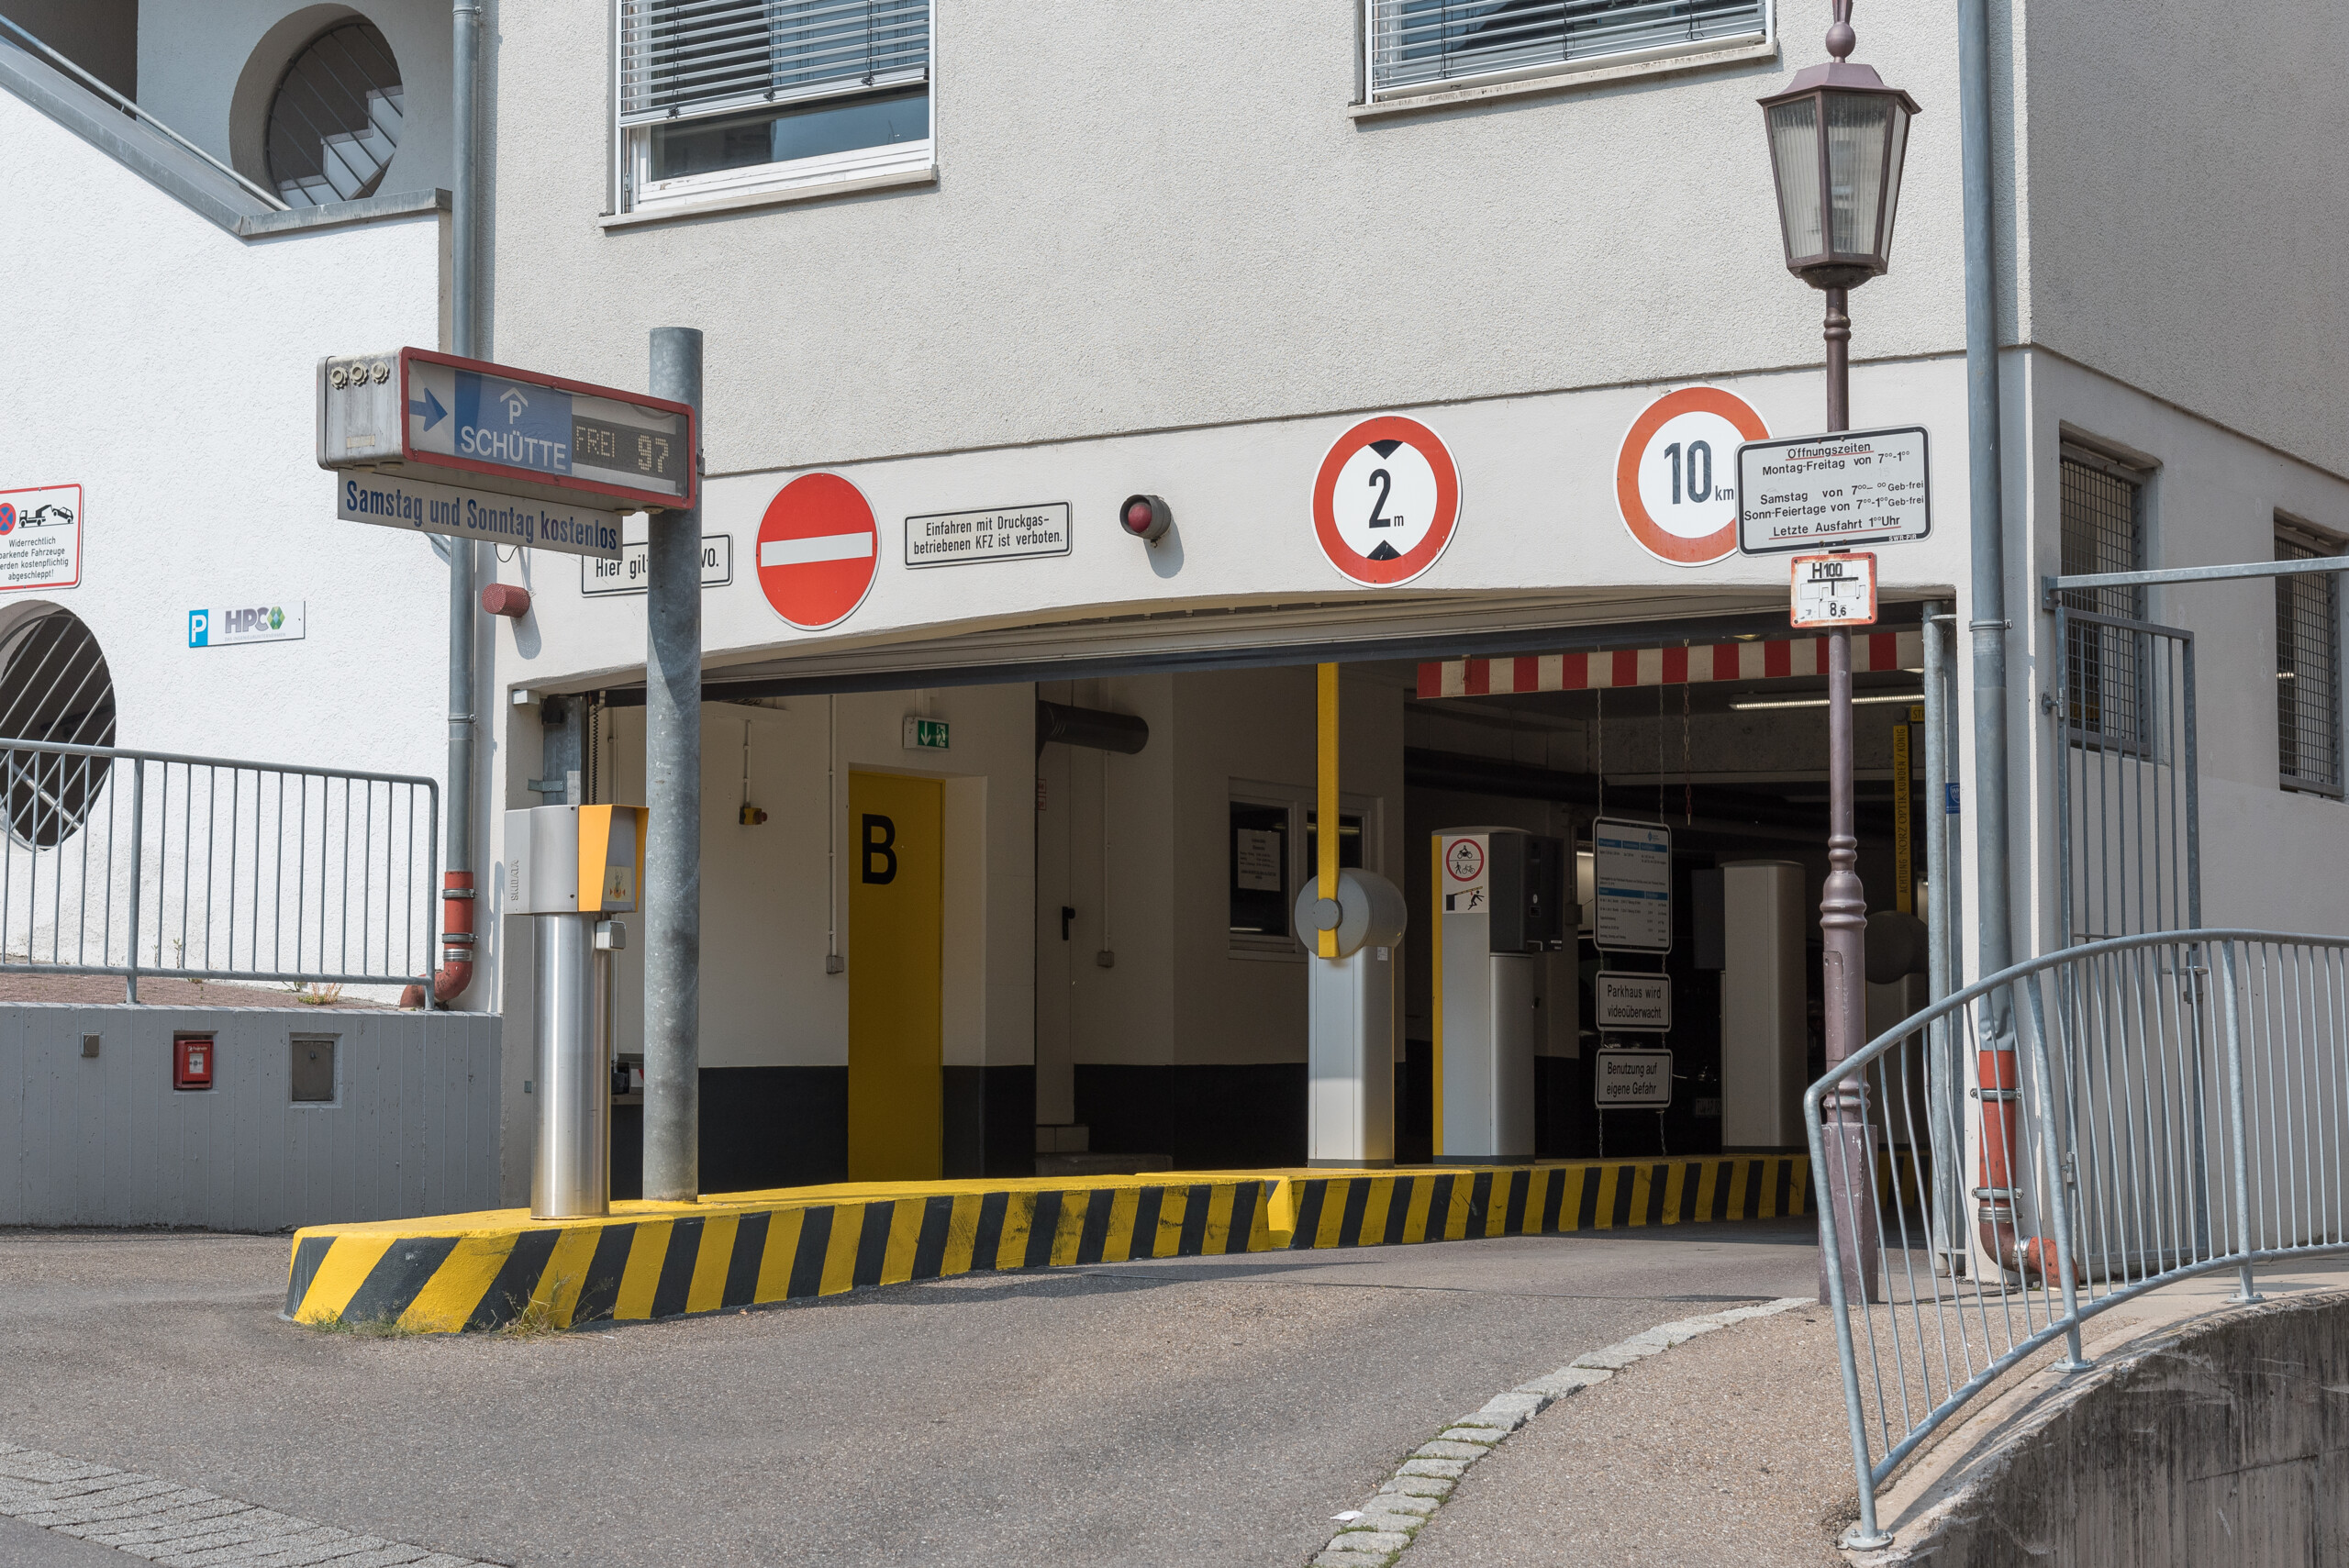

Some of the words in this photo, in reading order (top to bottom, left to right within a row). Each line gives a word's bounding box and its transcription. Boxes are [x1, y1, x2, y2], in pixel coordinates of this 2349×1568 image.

[509, 400, 522, 425] P
[461, 426, 566, 471] SCHÜTTE
[576, 426, 615, 458] FREI
[638, 434, 669, 473] 97
[1787, 442, 1871, 460] Öffnungszeiten
[1664, 439, 1712, 505] 10
[1714, 484, 1734, 502] km
[1762, 459, 1845, 476] Montag-Freitag
[1854, 455, 1872, 467] von
[1368, 468, 1391, 528] 2
[1394, 515, 1404, 527] m
[1760, 492, 1809, 506] Samstag
[1822, 488, 1843, 498] von
[1887, 480, 1924, 492] Geb-frei
[347, 480, 423, 527] Samstag
[429, 497, 461, 528] und
[467, 499, 534, 544] Sonntag
[540, 510, 618, 550] kostenlos
[1743, 505, 1827, 521] Sonn-Feiertage
[1831, 501, 1851, 512] von
[1887, 495, 1924, 507] Geb-frei
[926, 520, 972, 537] Einfahren
[976, 517, 993, 532] mit
[997, 514, 1050, 530] Druckgas-
[1773, 526, 1809, 537] Letzte
[1815, 518, 1863, 533] Ausfahrt
[8, 536, 56, 548] Widerrechtlich
[31, 548, 65, 557] Fahrzeuge
[914, 539, 971, 555] betriebenen
[975, 534, 994, 550] KFZ
[998, 532, 1010, 547] ist
[1016, 530, 1063, 546] verboten.
[0, 562, 18, 570] erden
[21, 558, 69, 568] kostenpflichtig
[8, 569, 54, 582] abgeschleppt!
[596, 557, 622, 577] Hier
[629, 554, 649, 580] gil
[191, 615, 207, 643] P
[225, 606, 270, 634] HPC
[862, 813, 897, 884] B
[1607, 984, 1642, 999] Parkhaus
[1645, 985, 1662, 999] wird
[1607, 1005, 1662, 1019] videoüberwacht
[1607, 1062, 1644, 1078] Benutzung
[1645, 1062, 1658, 1075] auf
[1607, 1083, 1630, 1097] eigene
[1632, 1081, 1657, 1095] Gefahr
